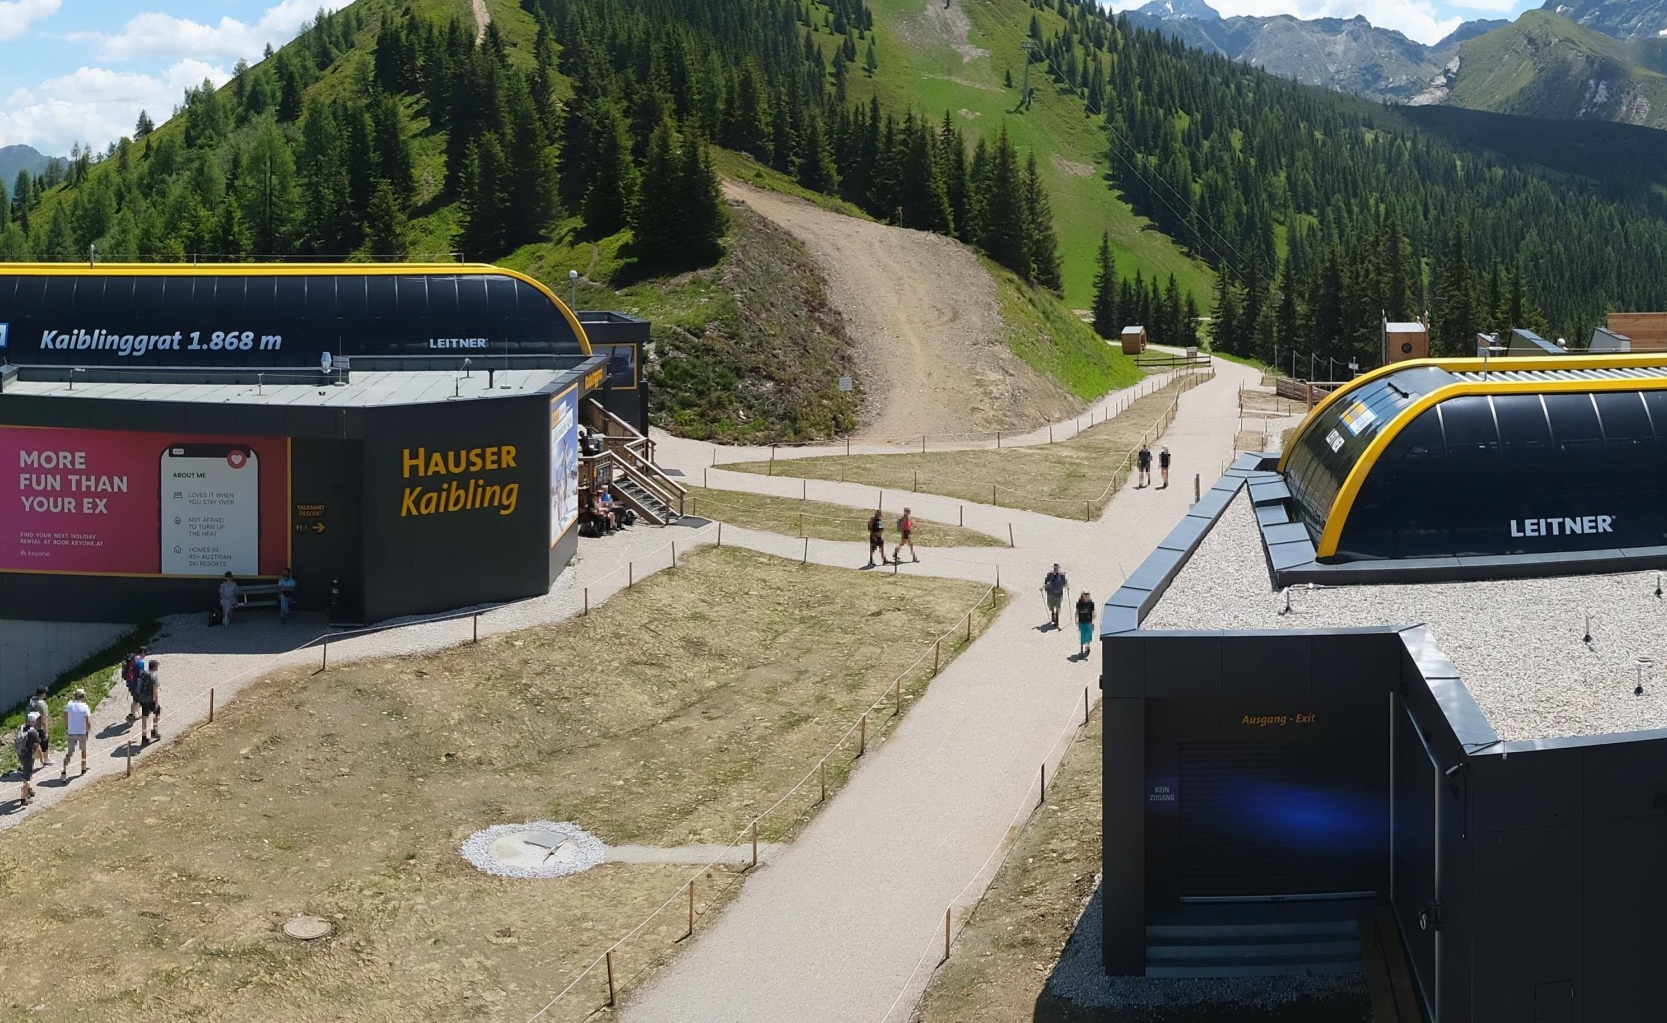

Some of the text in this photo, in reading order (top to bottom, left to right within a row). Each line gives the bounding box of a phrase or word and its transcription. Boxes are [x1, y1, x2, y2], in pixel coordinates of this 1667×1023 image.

[40, 328, 282, 357] Kaiblinggrat 1.868 m
[429, 338, 488, 349] LEITNER
[19, 450, 86, 469] MORE
[403, 445, 517, 477] HAUSER
[19, 474, 128, 493] FUN THAN
[21, 496, 108, 514] YOUR EX
[401, 480, 519, 517] Kaibling
[1510, 515, 1613, 537] LEITNER
[1242, 714, 1287, 726] Ausgang
[1296, 713, 1316, 723] Exit
